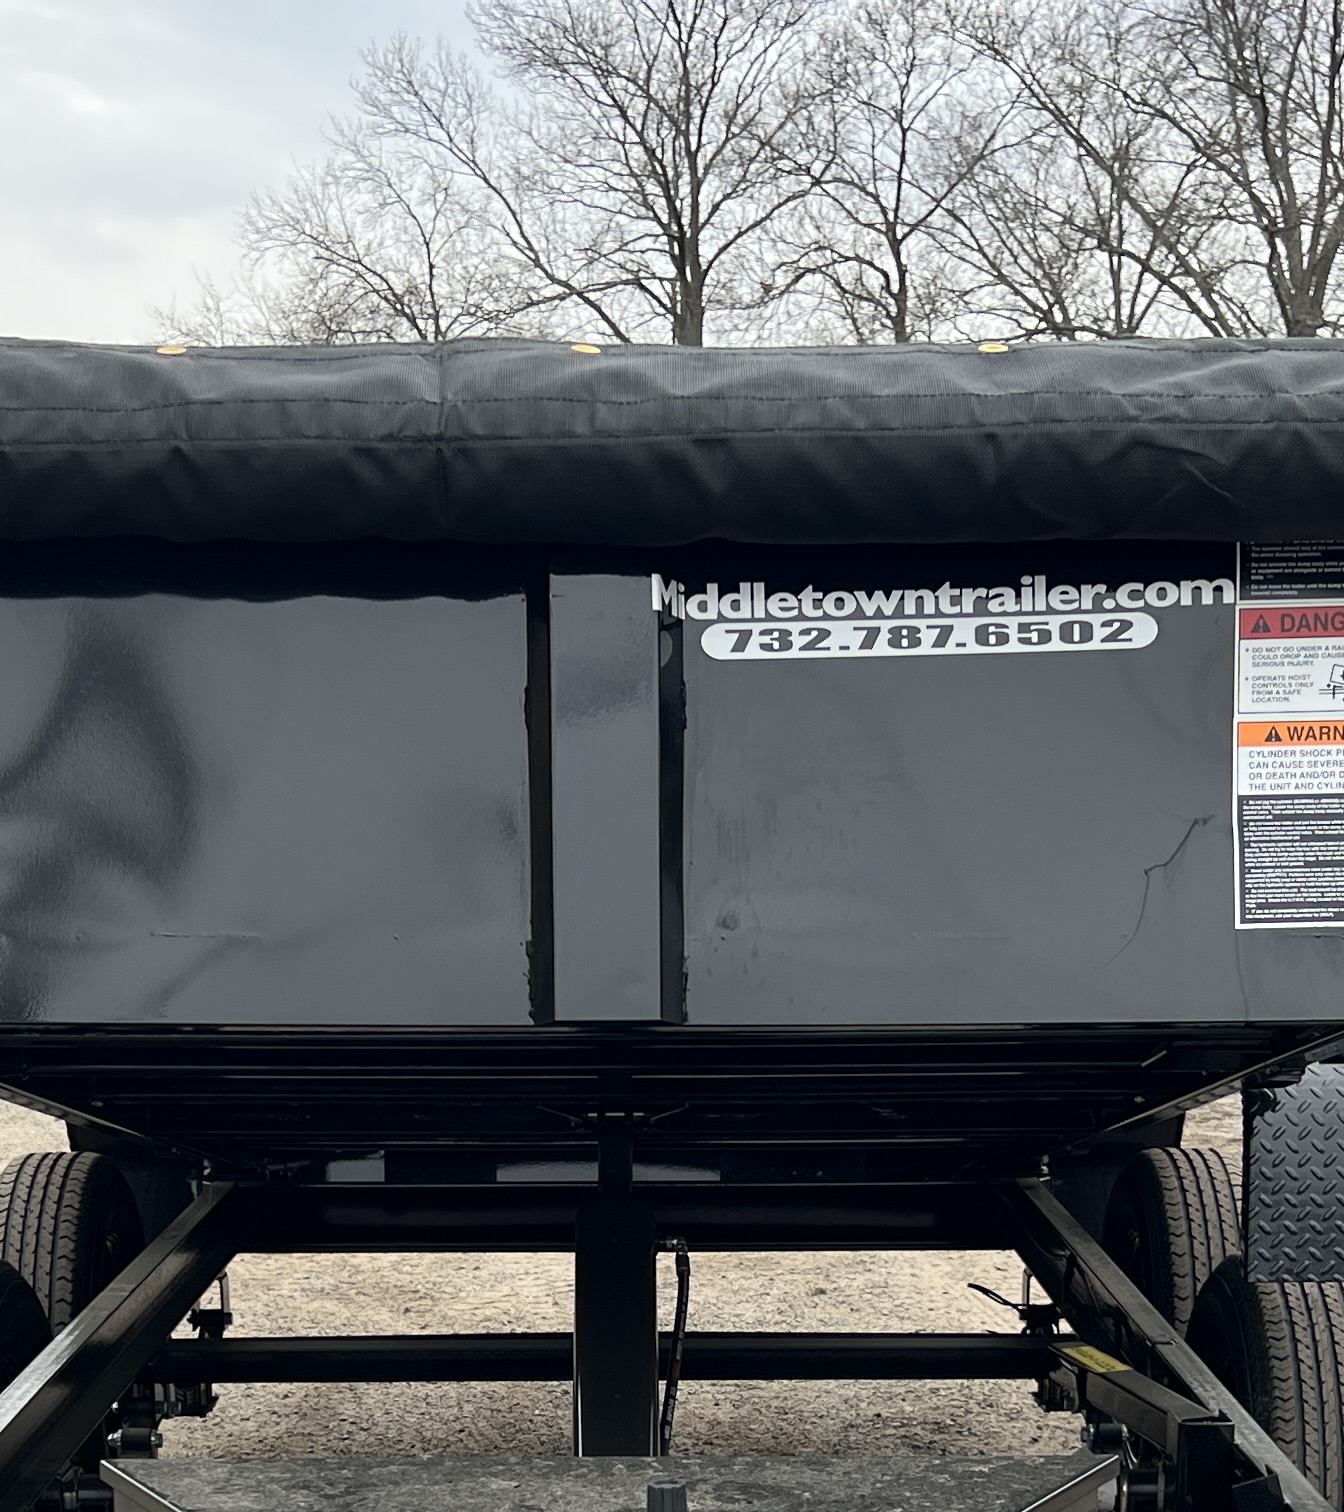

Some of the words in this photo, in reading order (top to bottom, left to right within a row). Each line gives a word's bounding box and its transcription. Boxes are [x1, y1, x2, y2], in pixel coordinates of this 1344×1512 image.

[651, 573, 1235, 620] Middletowntrailer.com
[725, 619, 1134, 653] 732.787.6502
[1249, 750, 1296, 758] CYLINDER
[1300, 749, 1333, 757] SHOCK
[1249, 761, 1268, 769] CAN
[1271, 761, 1304, 769] CAUSE
[1307, 760, 1344, 768] SEVERE
[1266, 772, 1296, 780] DEATH
[1249, 783, 1267, 791] THE
[1294, 782, 1314, 790] AND
